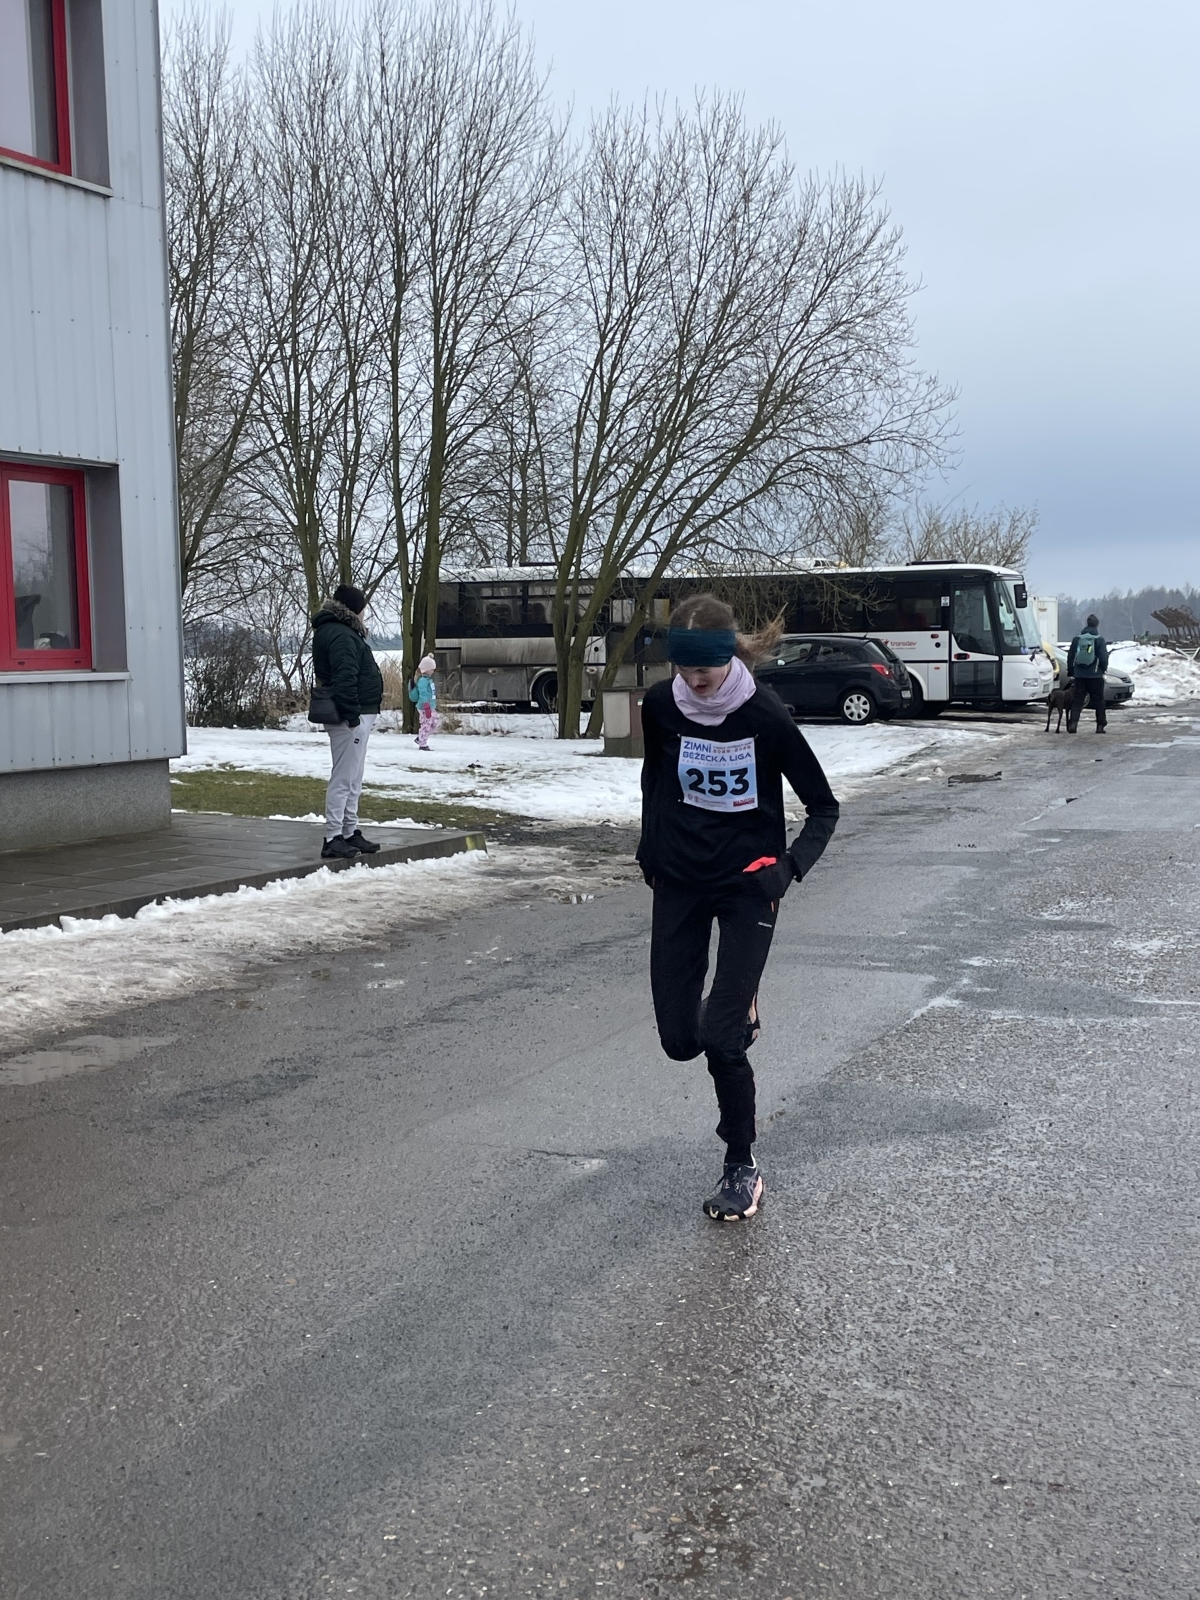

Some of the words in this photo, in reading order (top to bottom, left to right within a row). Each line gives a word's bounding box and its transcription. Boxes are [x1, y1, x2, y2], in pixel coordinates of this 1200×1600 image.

[684, 741, 711, 753] ZIMNÍ
[729, 752, 752, 761] LIGA
[685, 767, 750, 797] 253
